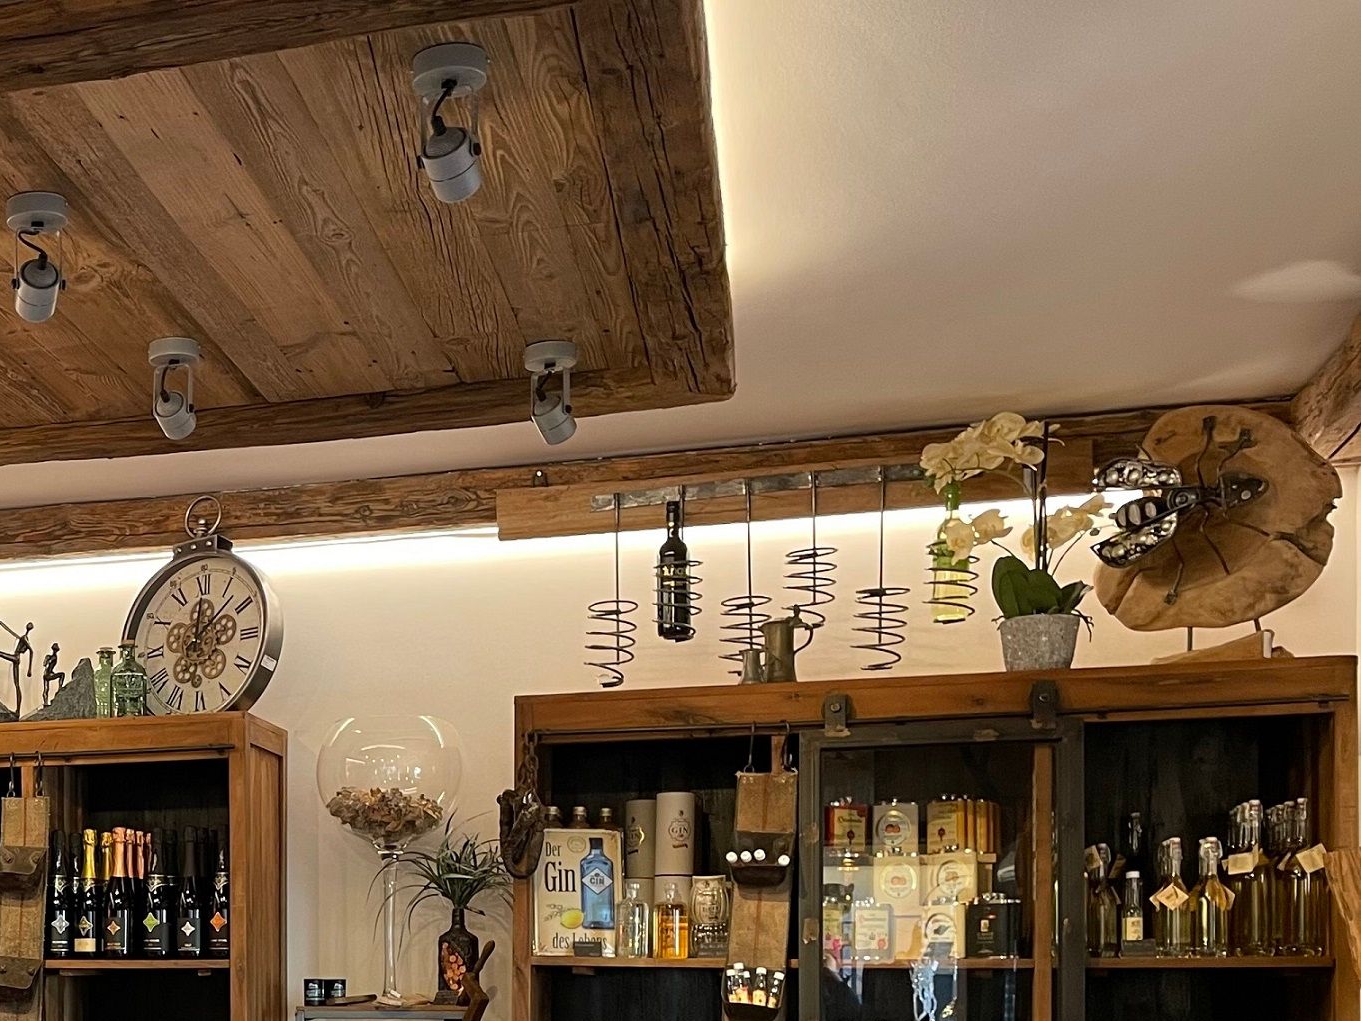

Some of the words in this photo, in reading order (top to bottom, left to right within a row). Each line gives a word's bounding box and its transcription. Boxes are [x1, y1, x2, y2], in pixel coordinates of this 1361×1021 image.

[545, 842, 561, 857] Der
[544, 861, 576, 893] Gin
[589, 877, 605, 886] GIN
[552, 932, 569, 949] des
